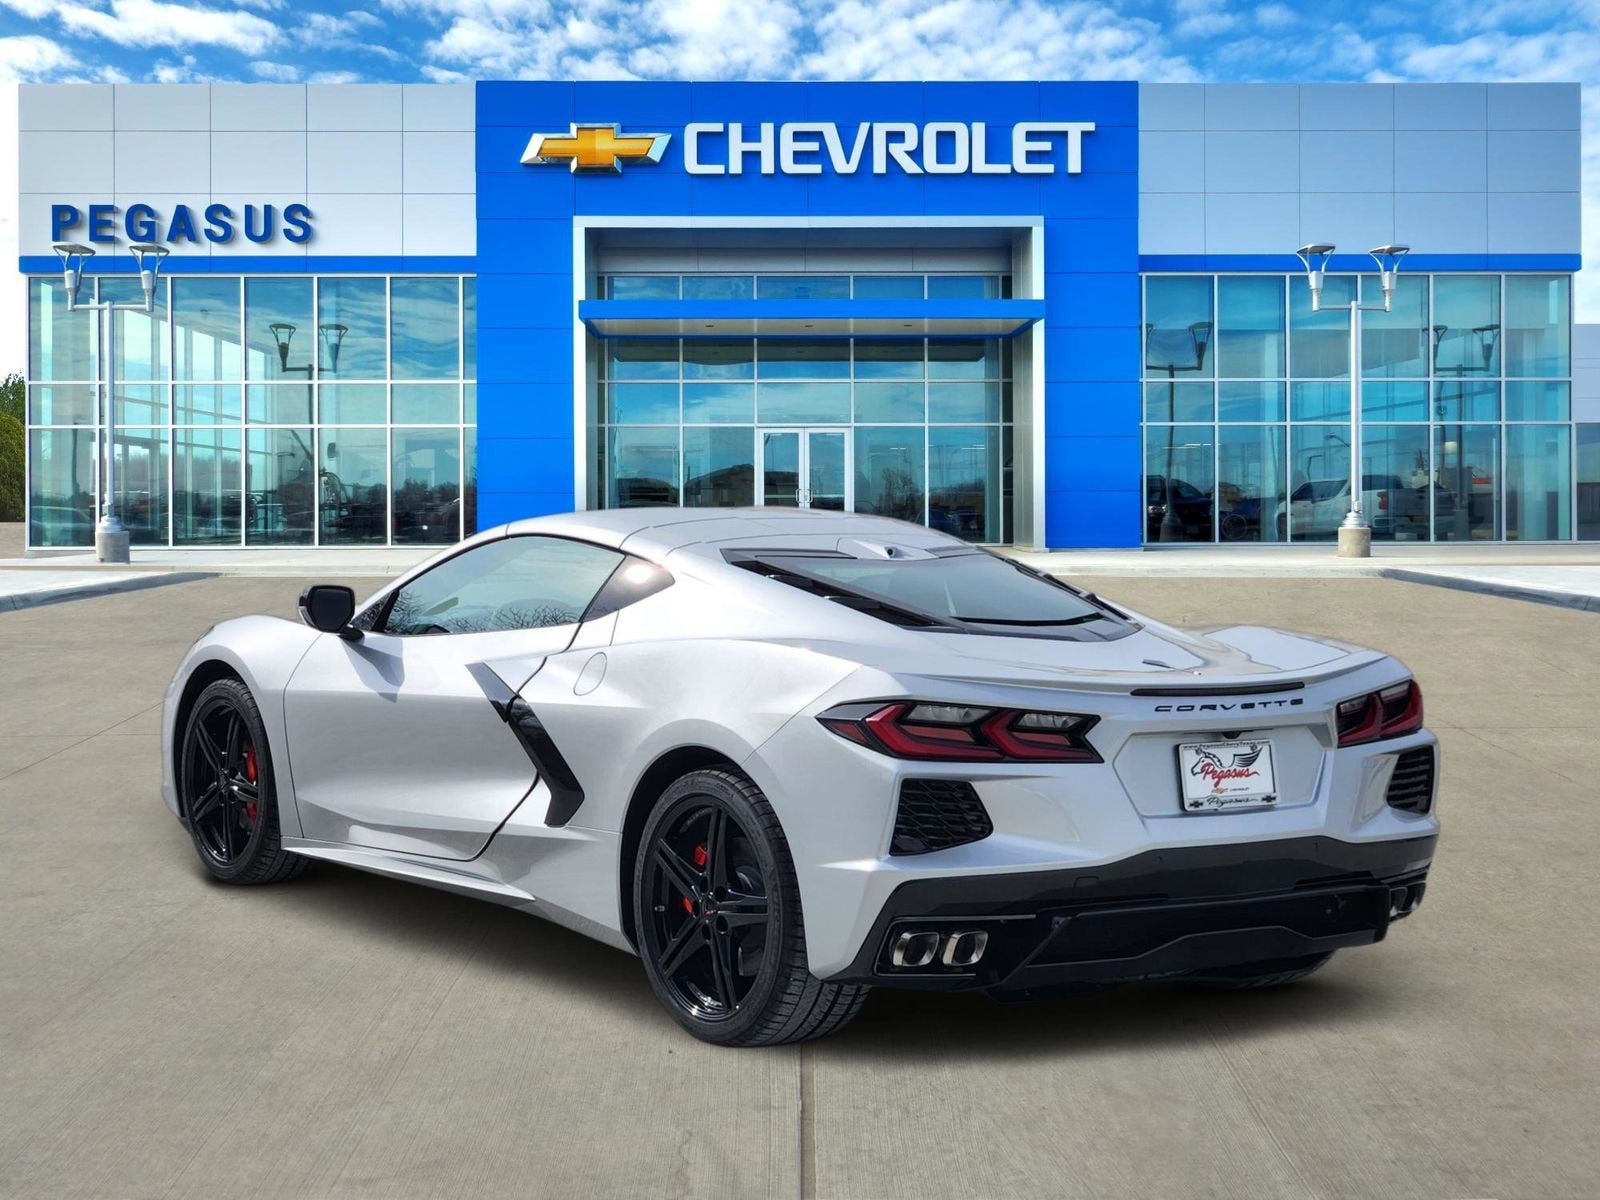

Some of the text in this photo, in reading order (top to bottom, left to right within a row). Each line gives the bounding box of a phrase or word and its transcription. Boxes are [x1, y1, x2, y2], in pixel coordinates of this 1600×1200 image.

[683, 121, 1096, 176] CHEVROLET
[51, 203, 314, 244] PEGASUS
[1154, 698, 1304, 712] CORVETTE
[1200, 762, 1260, 788] Pegasus
